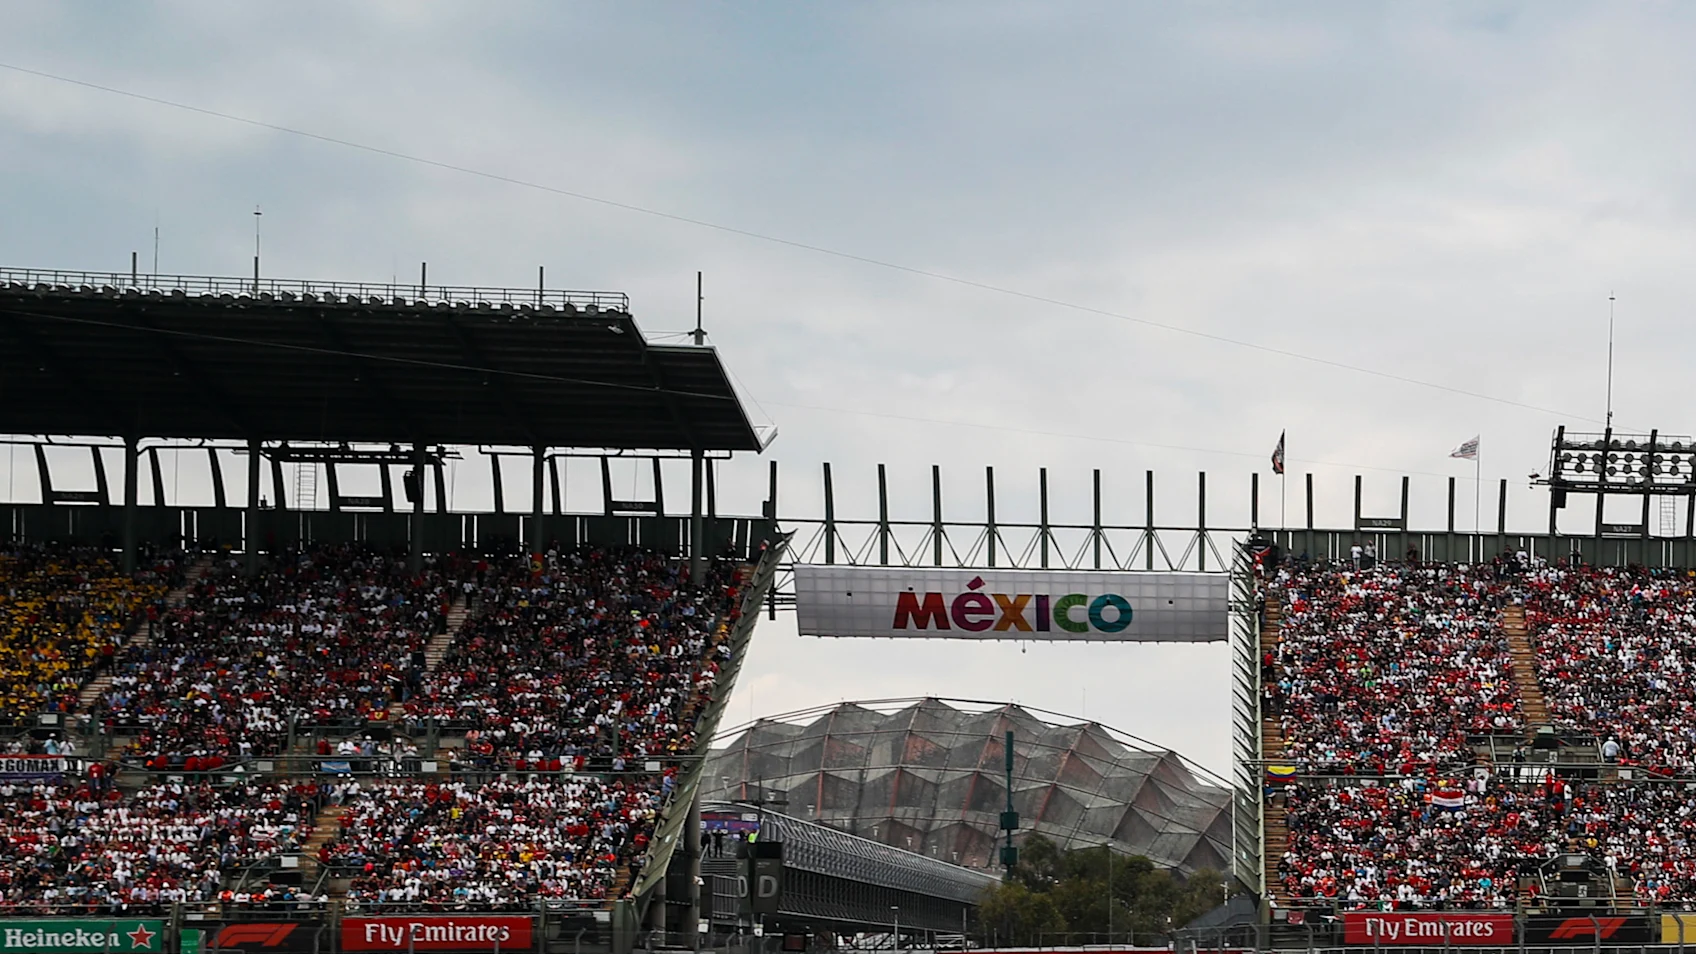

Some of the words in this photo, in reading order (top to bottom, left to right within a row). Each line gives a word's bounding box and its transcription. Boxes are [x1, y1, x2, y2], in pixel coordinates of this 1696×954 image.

[4, 928, 120, 948] Heineken
[365, 923, 404, 946] Fly
[411, 923, 509, 943] Emirates
[1365, 918, 1400, 939] Fly
[1405, 919, 1494, 938] Emirates
